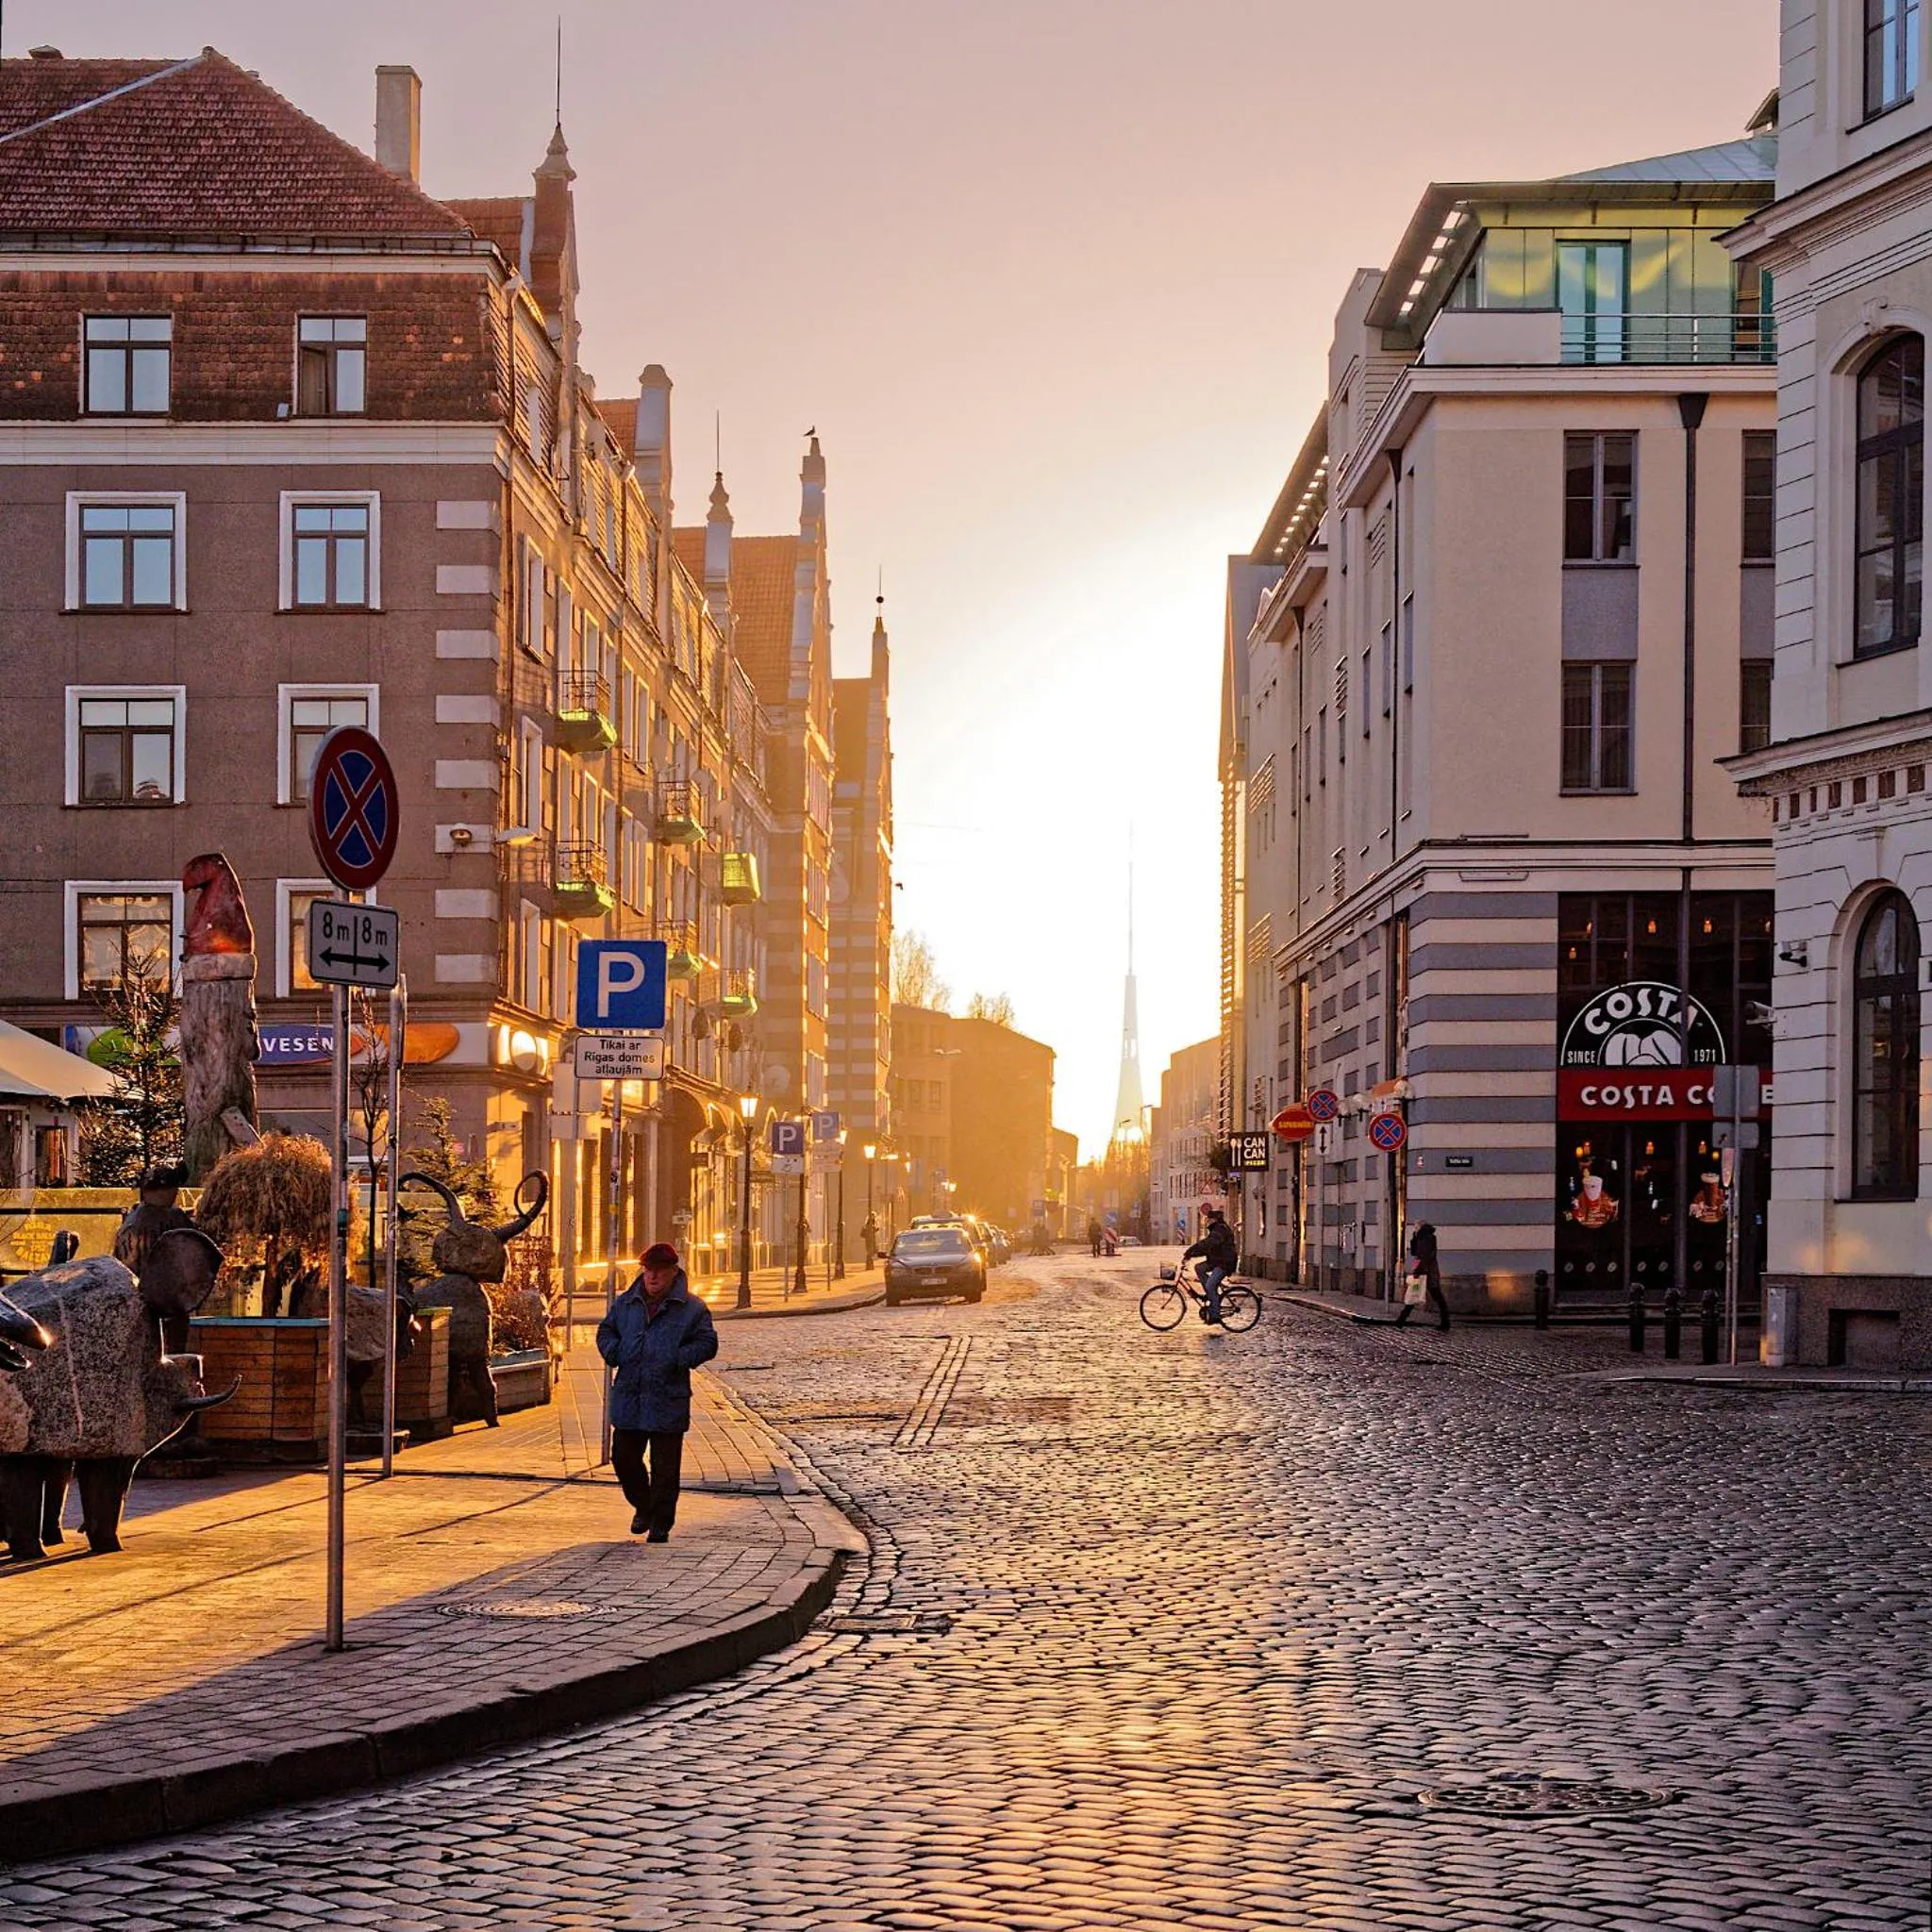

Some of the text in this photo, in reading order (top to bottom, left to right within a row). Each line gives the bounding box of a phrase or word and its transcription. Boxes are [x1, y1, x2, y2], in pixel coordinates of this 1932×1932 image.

[597, 951, 645, 1018] P
[1585, 989, 1698, 1035] COSTA
[262, 1037, 334, 1052] VESEN
[600, 1039, 641, 1050] Tikai ar
[618, 1053, 656, 1063] domes
[1567, 1049, 1717, 1063] SINCE 1971
[1581, 1085, 1674, 1108] COSTA
[819, 1115, 834, 1137] P
[778, 1124, 797, 1151] P
[1243, 1137, 1266, 1148] CAN
[1243, 1148, 1266, 1159] CAN
